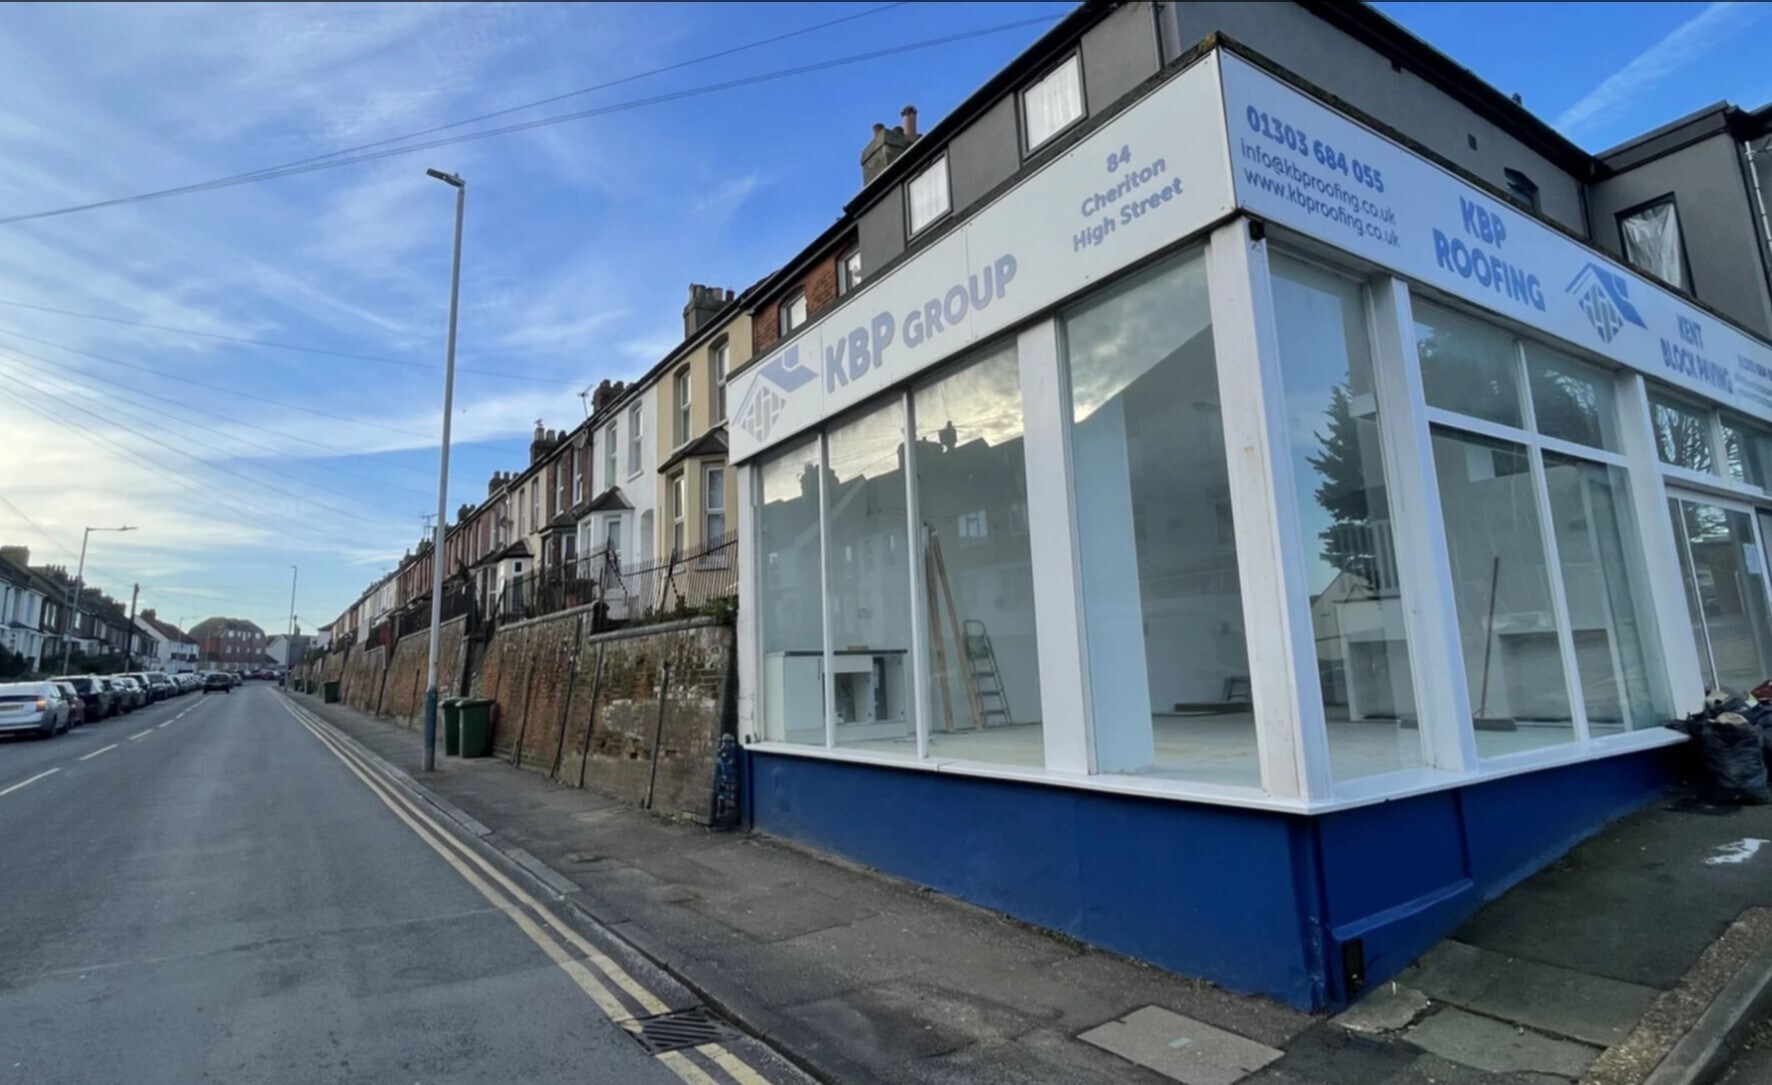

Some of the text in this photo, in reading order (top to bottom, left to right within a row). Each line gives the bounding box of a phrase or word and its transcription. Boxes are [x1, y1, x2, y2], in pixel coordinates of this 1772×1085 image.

[1080, 158, 1166, 217] Cheriton
[1106, 144, 1132, 173] 84
[1240, 138, 1397, 225] info@kbproofing.co.uk
[1246, 105, 1384, 193] 01303 684 055
[1073, 177, 1183, 252] High Street
[1244, 167, 1401, 247] www.kbproofing.co.uk
[1459, 195, 1507, 249] KBP
[1432, 227, 1546, 312] ROOFING
[825, 253, 1018, 394] KBP GROUP
